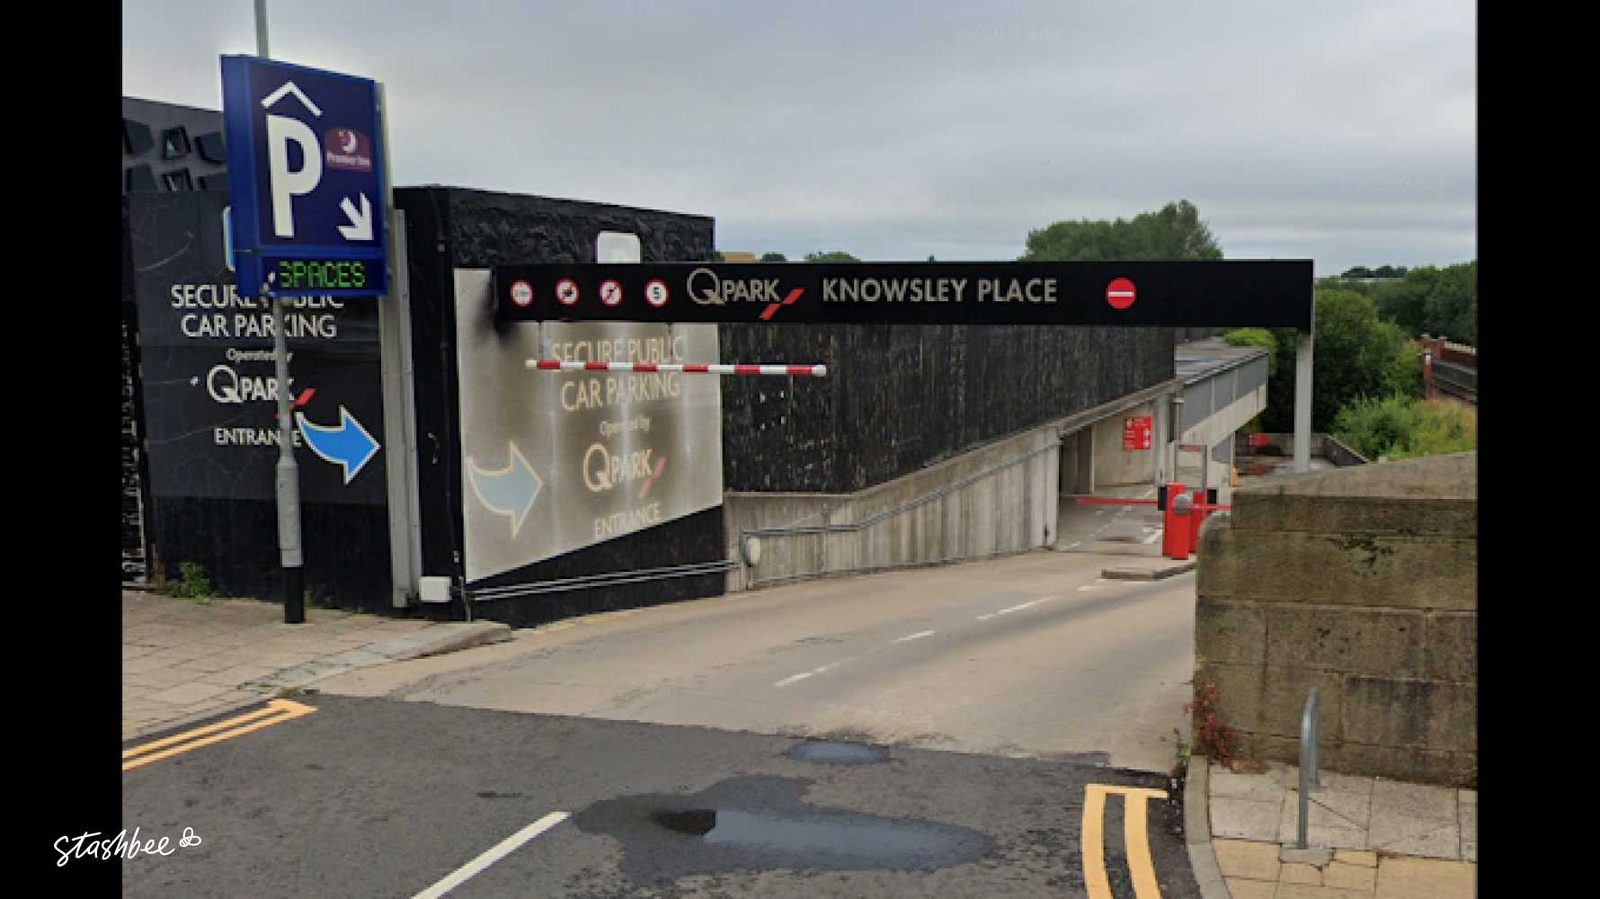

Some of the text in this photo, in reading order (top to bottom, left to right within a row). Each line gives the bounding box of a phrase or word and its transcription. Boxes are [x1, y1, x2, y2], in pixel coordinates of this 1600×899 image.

[267, 114, 323, 238] P
[280, 261, 366, 288] SPACES
[822, 277, 1058, 302] KNOWSLEY PLACE
[181, 313, 231, 337] CAR
[561, 371, 681, 412] CAR PARKING
[214, 427, 301, 447] ENTRANE
